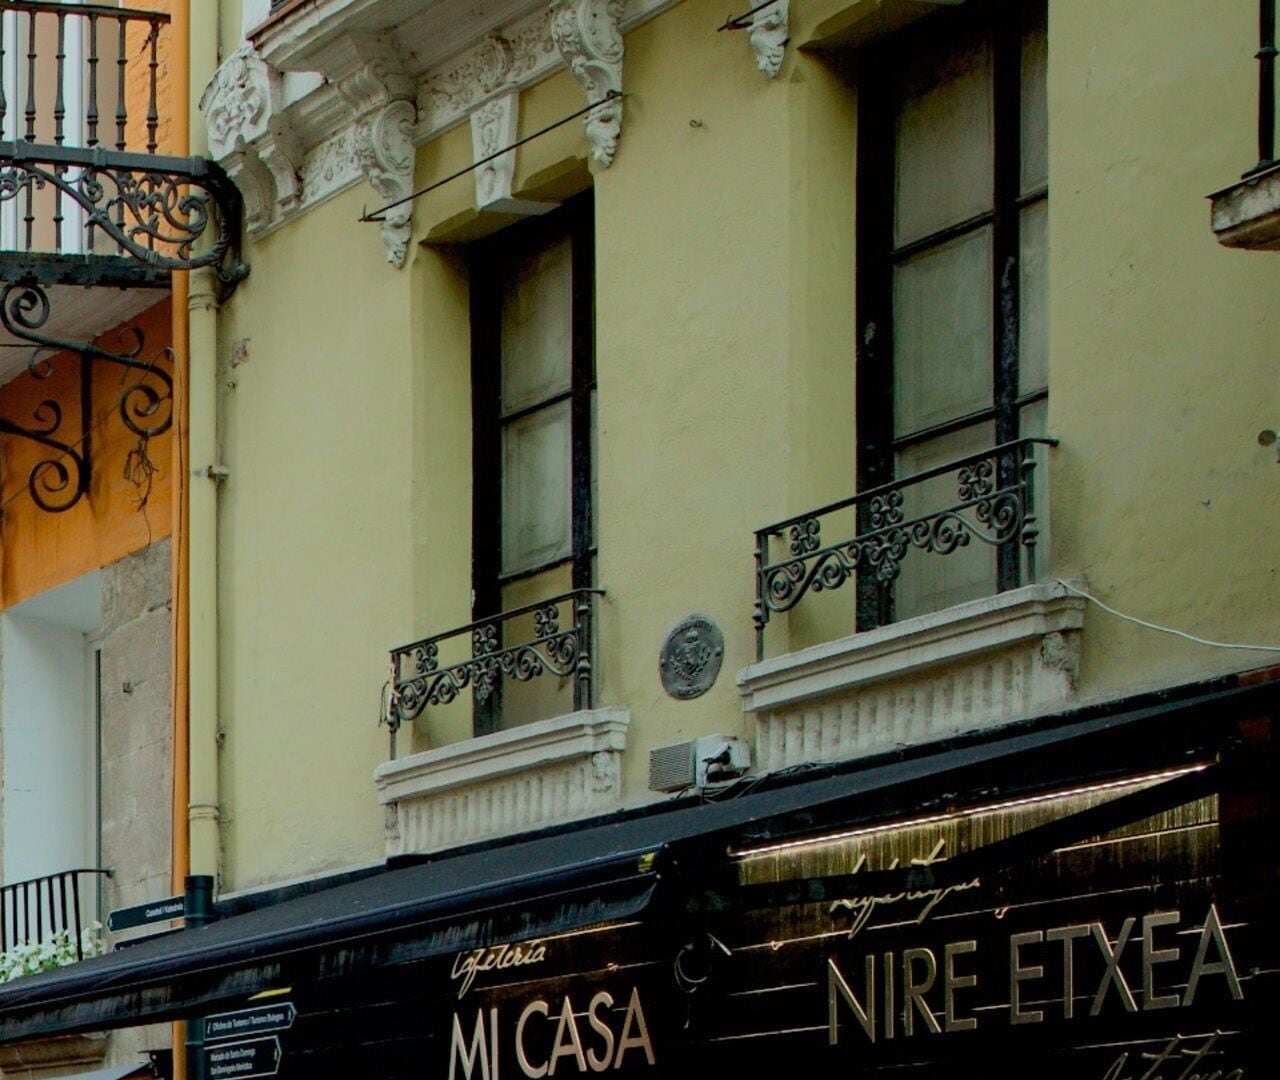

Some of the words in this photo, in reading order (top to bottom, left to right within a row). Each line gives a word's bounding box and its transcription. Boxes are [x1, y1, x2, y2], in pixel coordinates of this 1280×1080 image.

[515, 985, 656, 1079] CASA
[828, 940, 978, 1047] NIRE
[1009, 903, 1245, 1026] ETXEA
